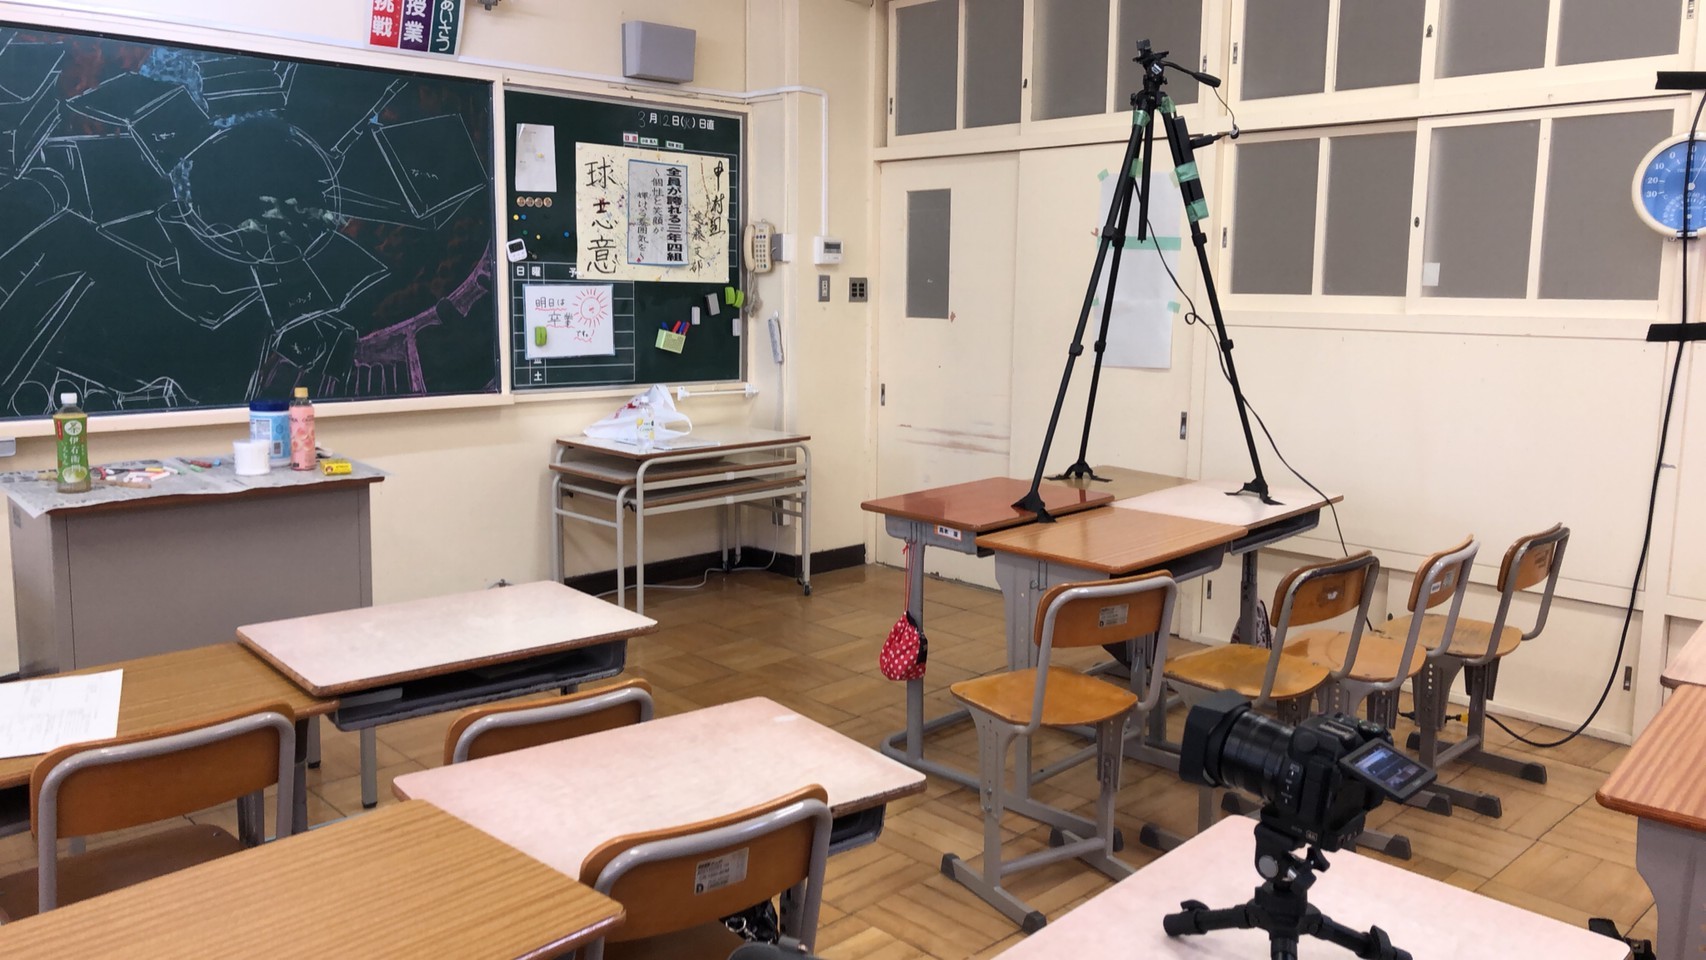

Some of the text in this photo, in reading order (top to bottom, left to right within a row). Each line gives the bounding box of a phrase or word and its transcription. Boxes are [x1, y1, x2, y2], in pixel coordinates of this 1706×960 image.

[403, 0, 426, 43] 授業
[436, 0, 455, 51] あいさつ
[699, 118, 715, 131] 日直
[666, 167, 683, 262] 全員が誇れる三年四組
[516, 265, 525, 277] 日
[532, 266, 541, 277] 曜
[535, 297, 565, 308] 明日は
[547, 310, 573, 328] 卒業
[533, 370, 543, 382] 土
